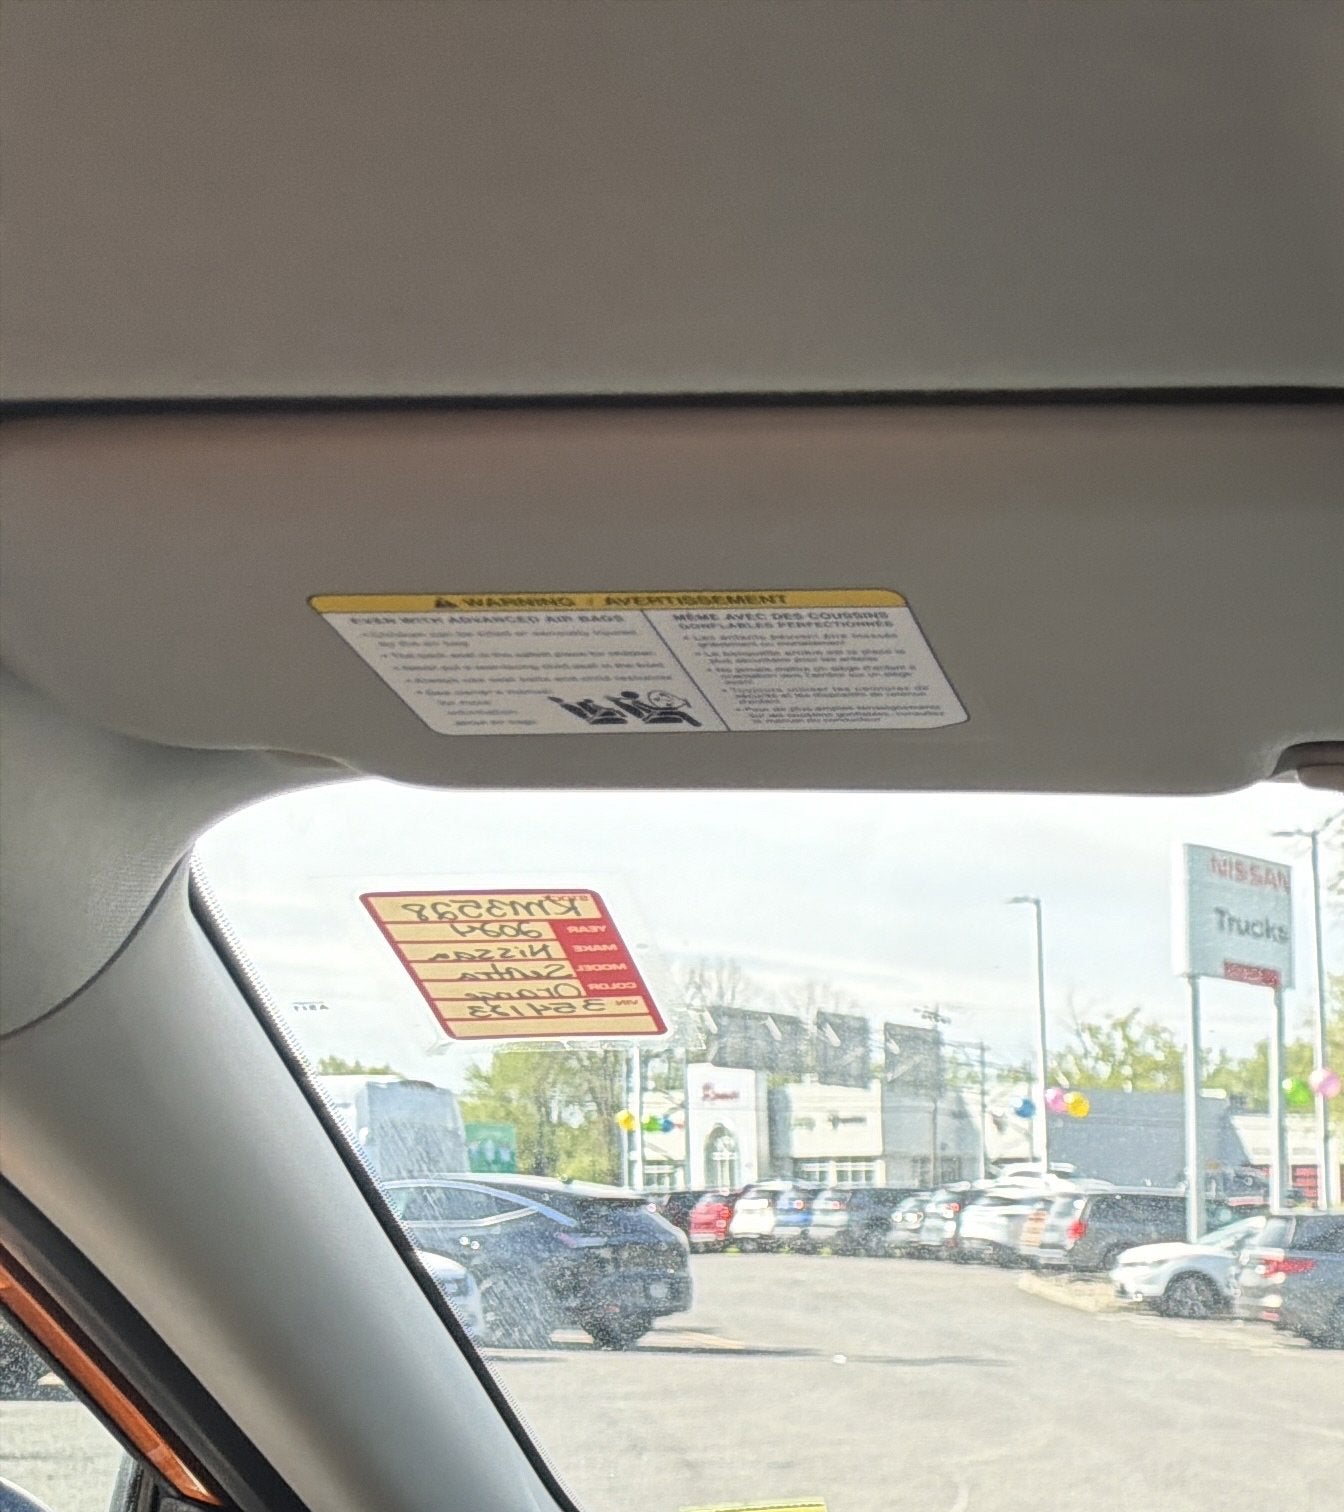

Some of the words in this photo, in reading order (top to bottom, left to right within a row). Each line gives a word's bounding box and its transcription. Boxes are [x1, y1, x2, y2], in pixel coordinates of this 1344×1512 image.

[462, 597, 577, 608] WARNING
[1210, 853, 1291, 892] NISSAN
[1213, 906, 1290, 945] Trucks
